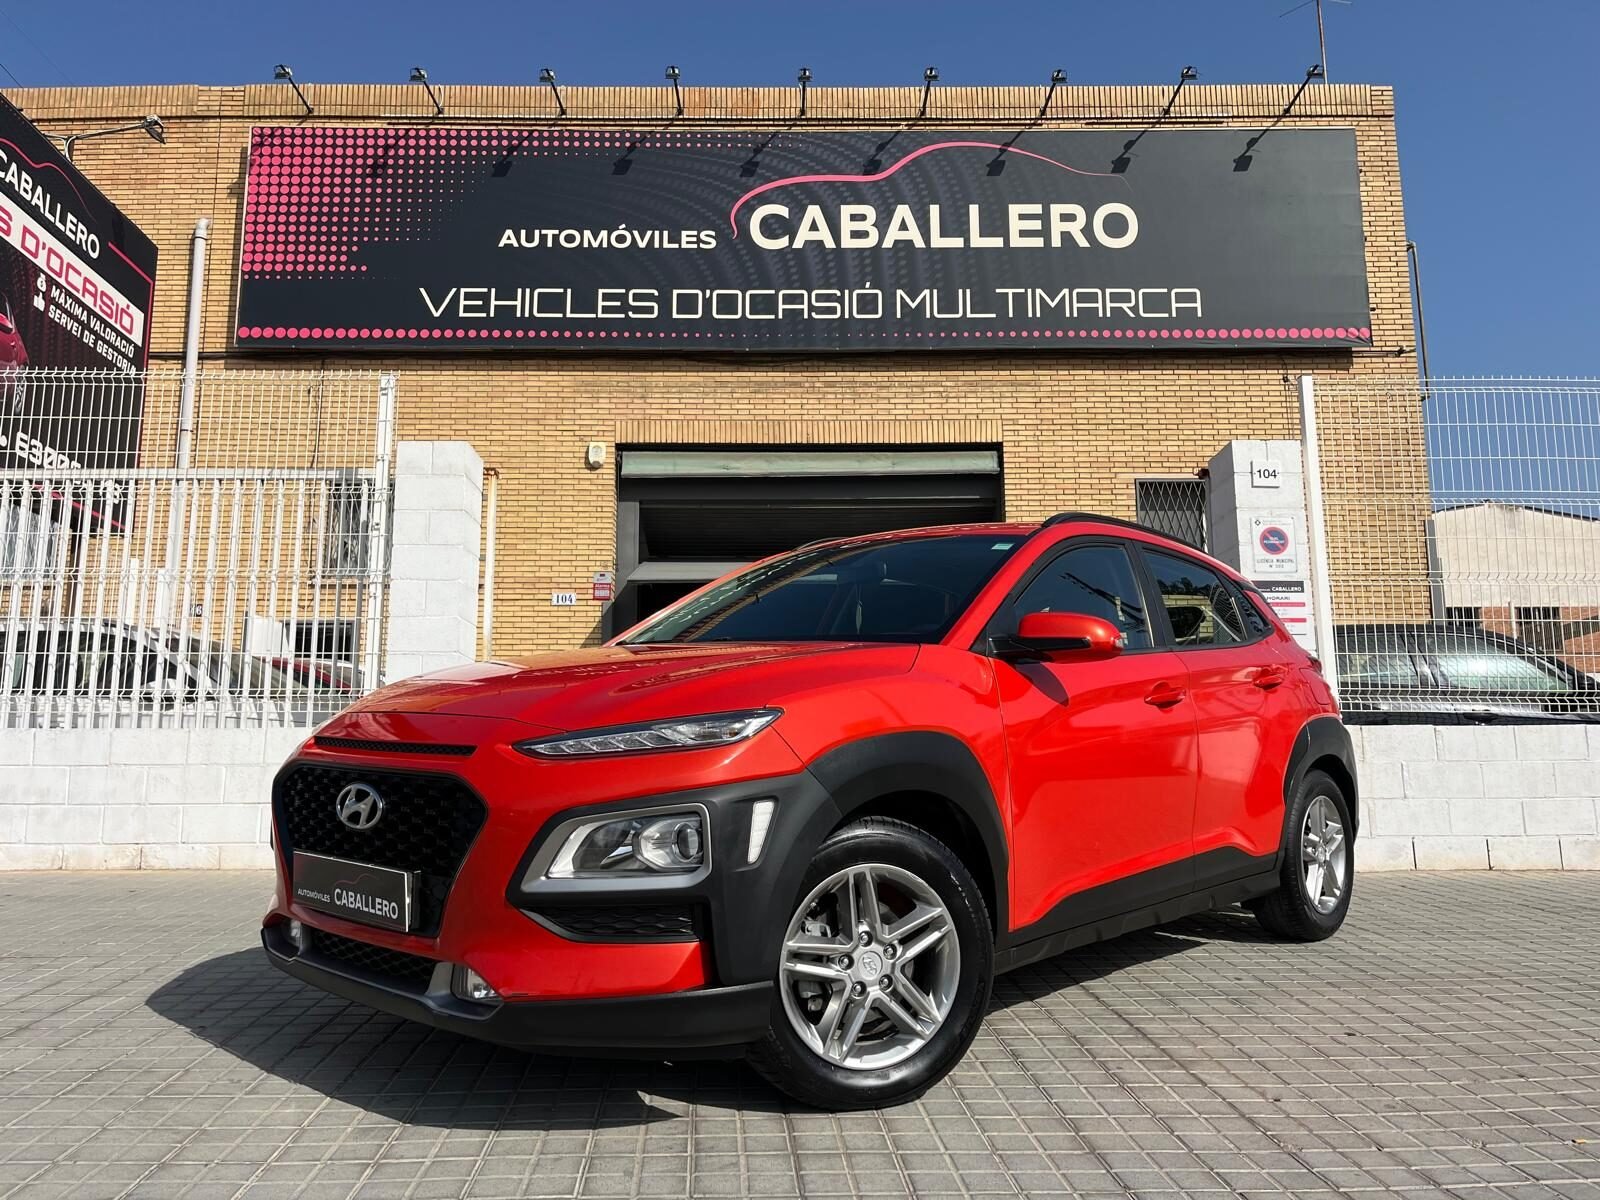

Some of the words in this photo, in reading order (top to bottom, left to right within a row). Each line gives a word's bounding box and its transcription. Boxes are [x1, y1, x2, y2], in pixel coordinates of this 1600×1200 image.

[498, 223, 717, 249] AUTOMÓVILES
[749, 202, 1139, 250] CABALLERO
[21, 224, 134, 336] D'OCASIÓ
[419, 287, 659, 318] VEHICLES
[672, 281, 883, 319] D'OCASIÓ
[896, 287, 1202, 319] MULTIMARCA
[48, 305, 82, 338] SERVEI
[83, 330, 96, 348] DE
[50, 285, 88, 324] MÀXIMA
[90, 315, 135, 358] VALORACIÓ
[1257, 469, 1277, 479] 104
[555, 594, 573, 604] 104
[297, 888, 331, 903] AUTOMÓVILES
[334, 888, 399, 920] CABALLERO
